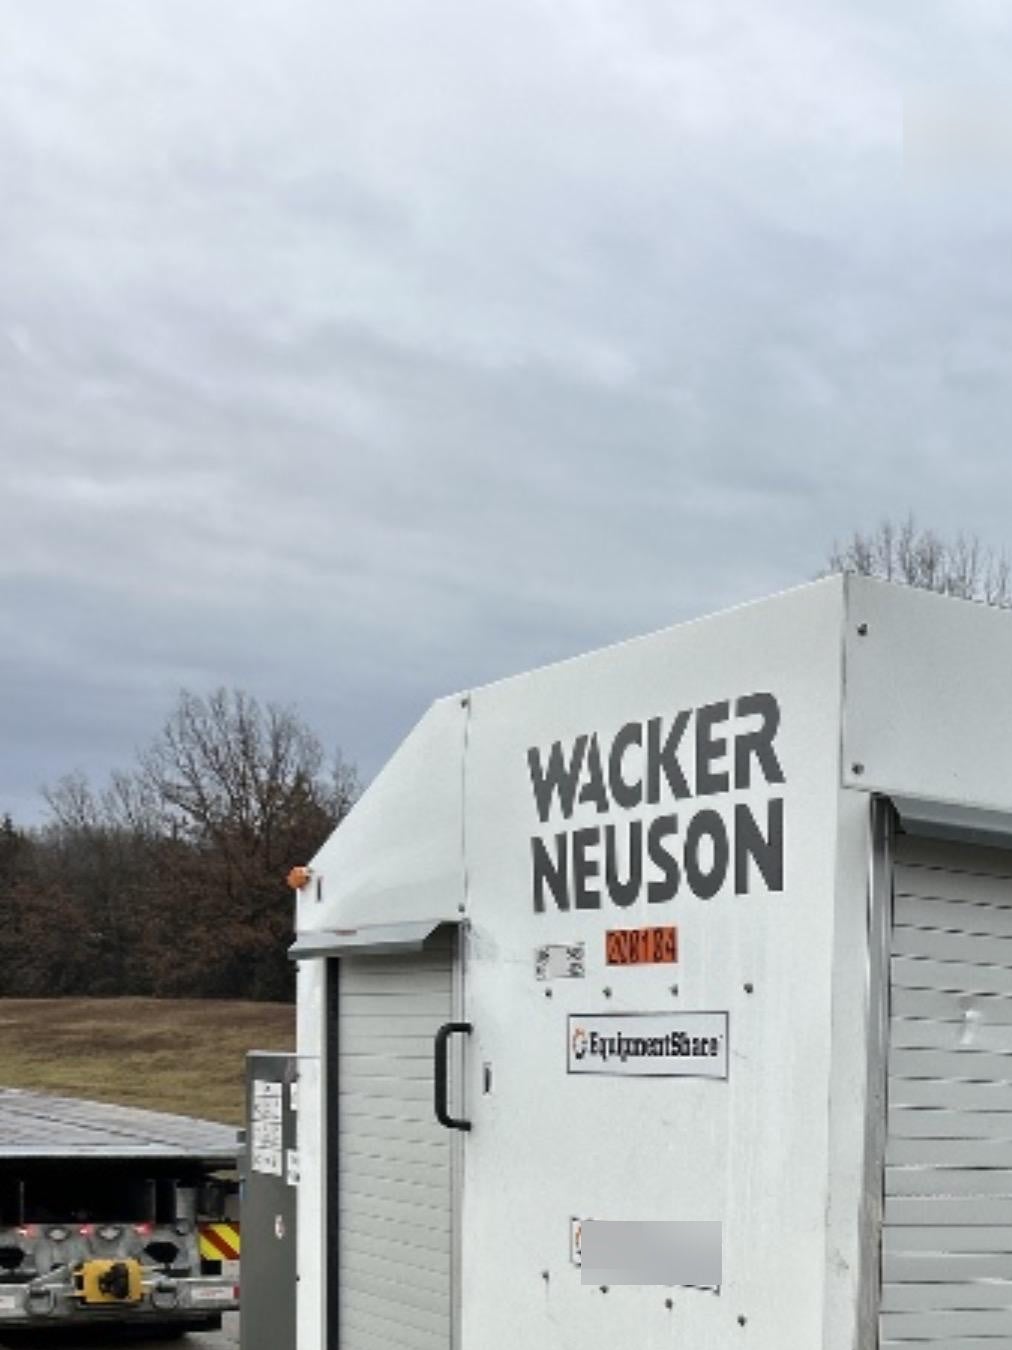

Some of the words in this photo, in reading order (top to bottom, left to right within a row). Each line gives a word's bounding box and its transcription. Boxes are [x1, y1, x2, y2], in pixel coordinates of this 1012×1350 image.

[527, 692, 786, 822] WACKER
[531, 798, 784, 913] NEUSON
[589, 1031, 719, 1063] EquipmentShare
